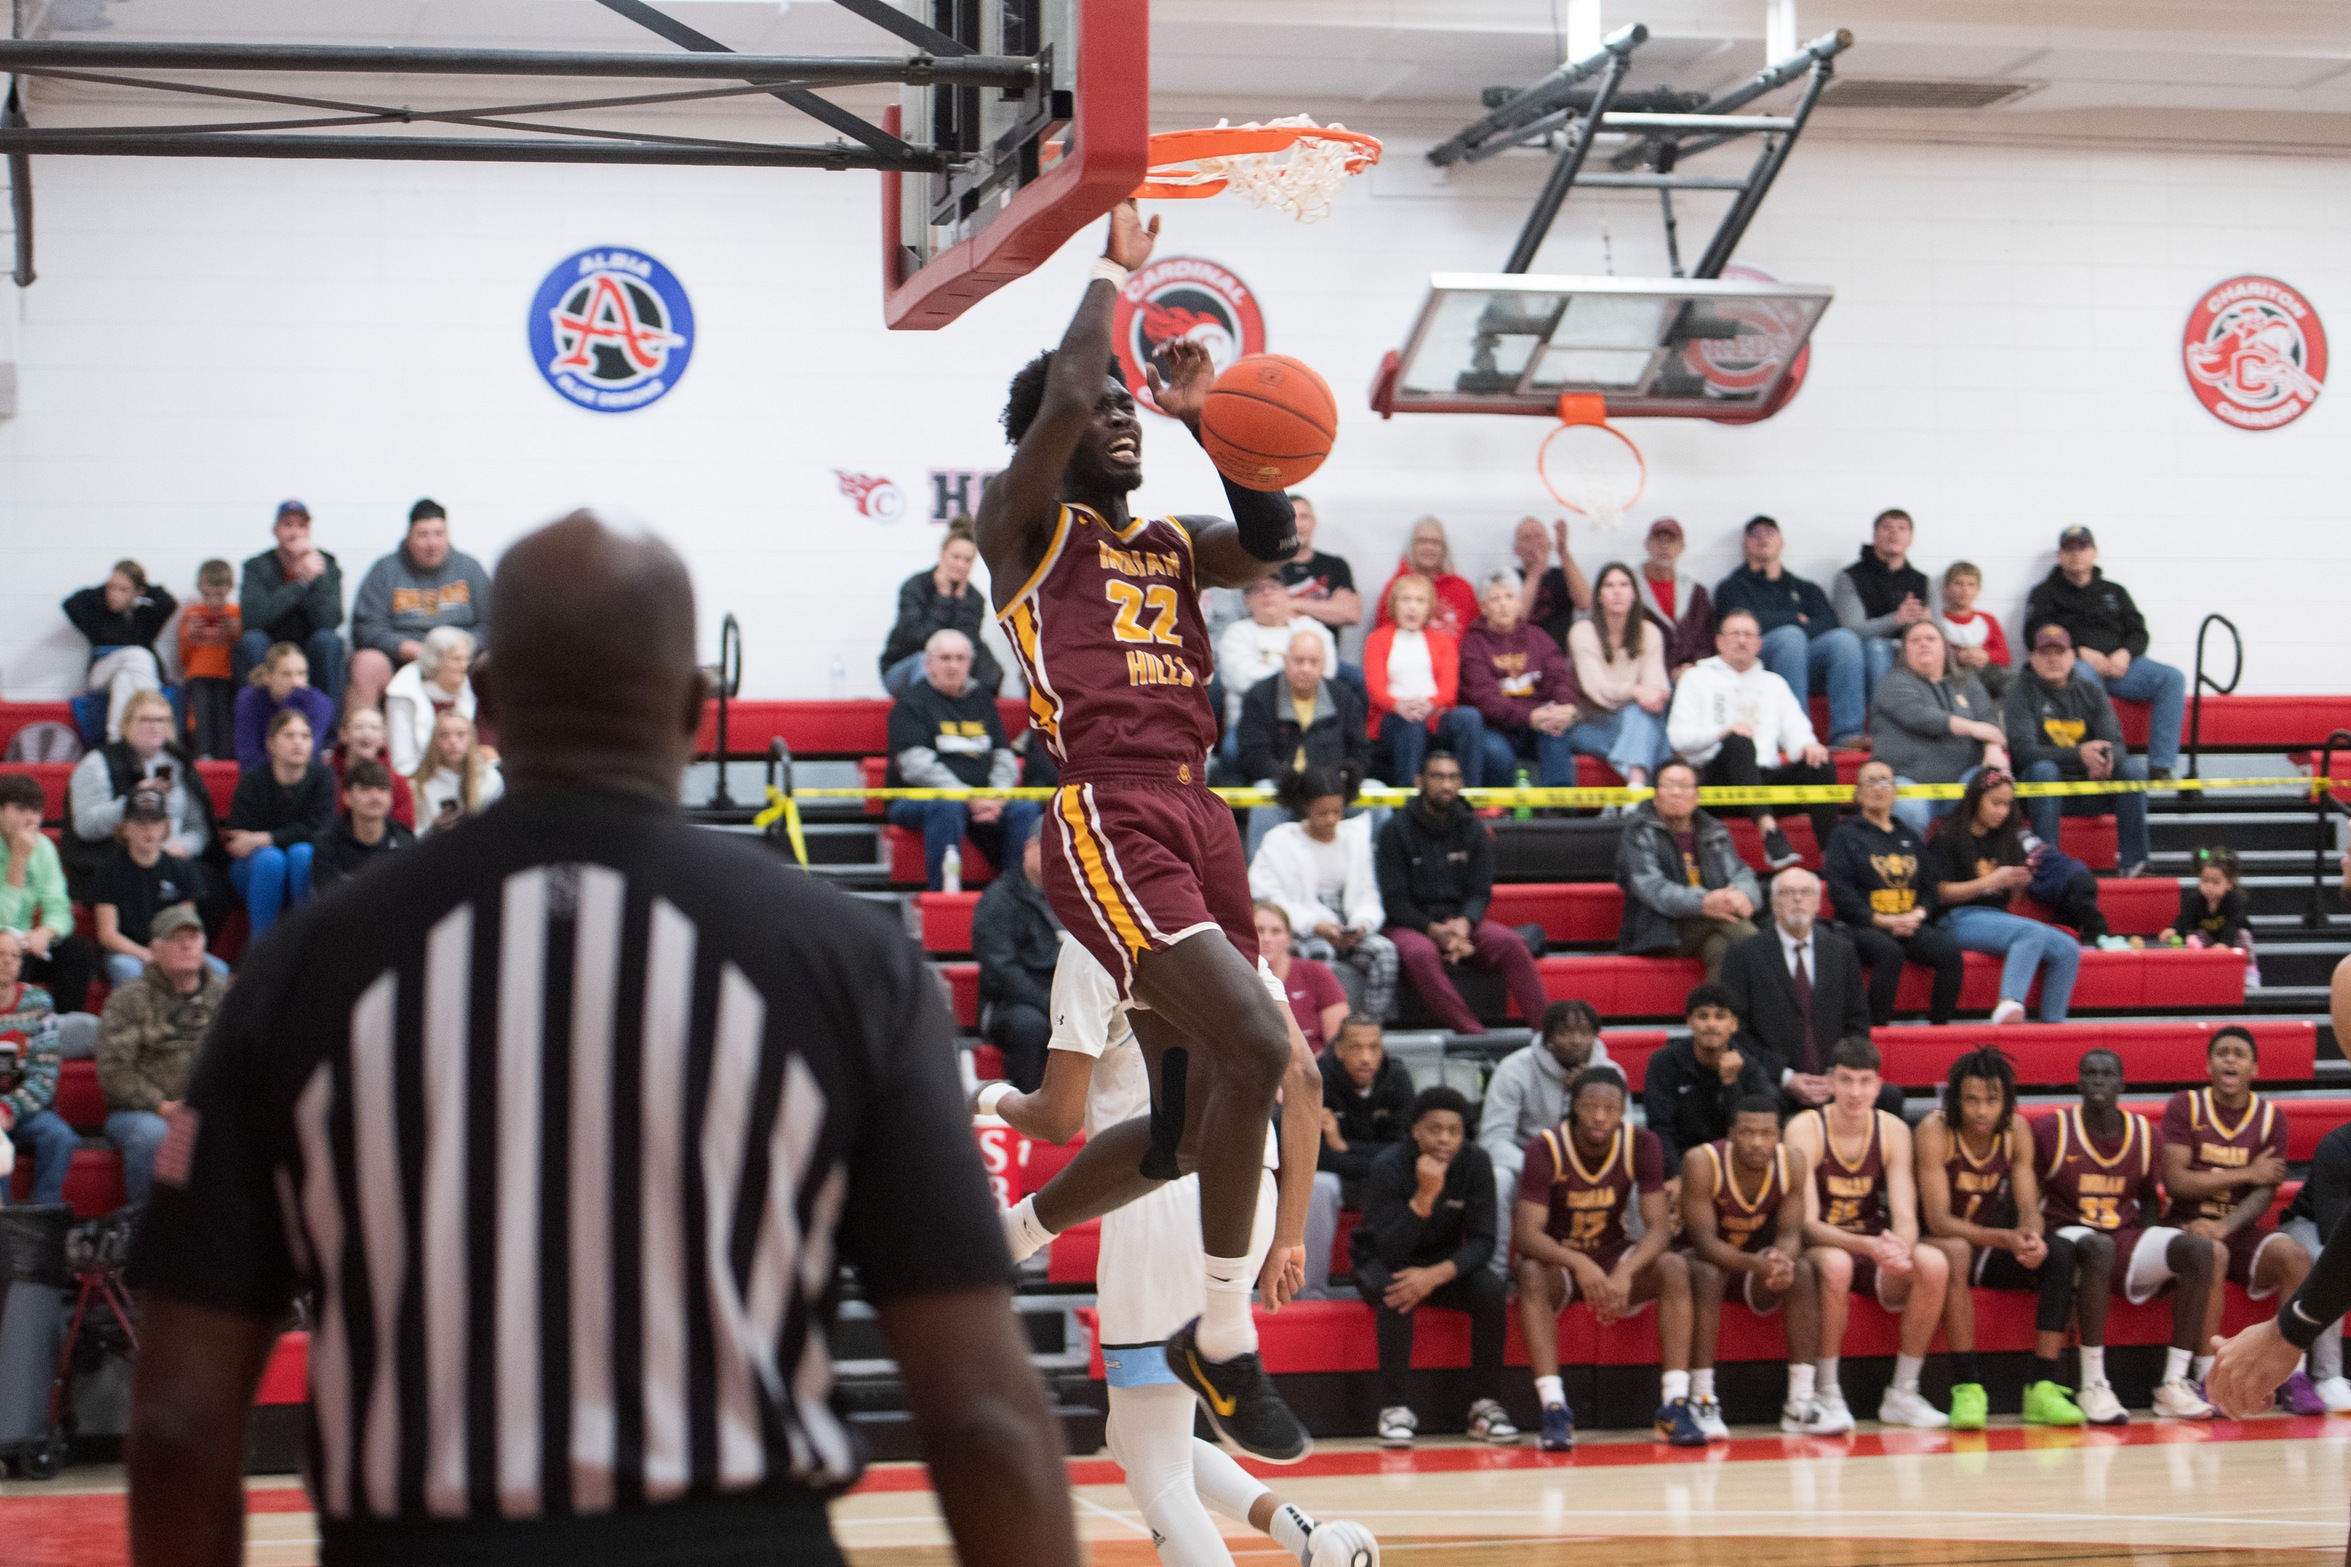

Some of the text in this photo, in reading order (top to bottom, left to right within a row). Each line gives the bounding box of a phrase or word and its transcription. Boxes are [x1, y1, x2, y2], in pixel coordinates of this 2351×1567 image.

[1126, 260, 1248, 306] CARDINAL
[2207, 283, 2308, 320] CHARITON
[1097, 539, 1181, 579] INDIAN
[1105, 579, 1184, 648] 22
[1126, 650, 1195, 688] HILLS
